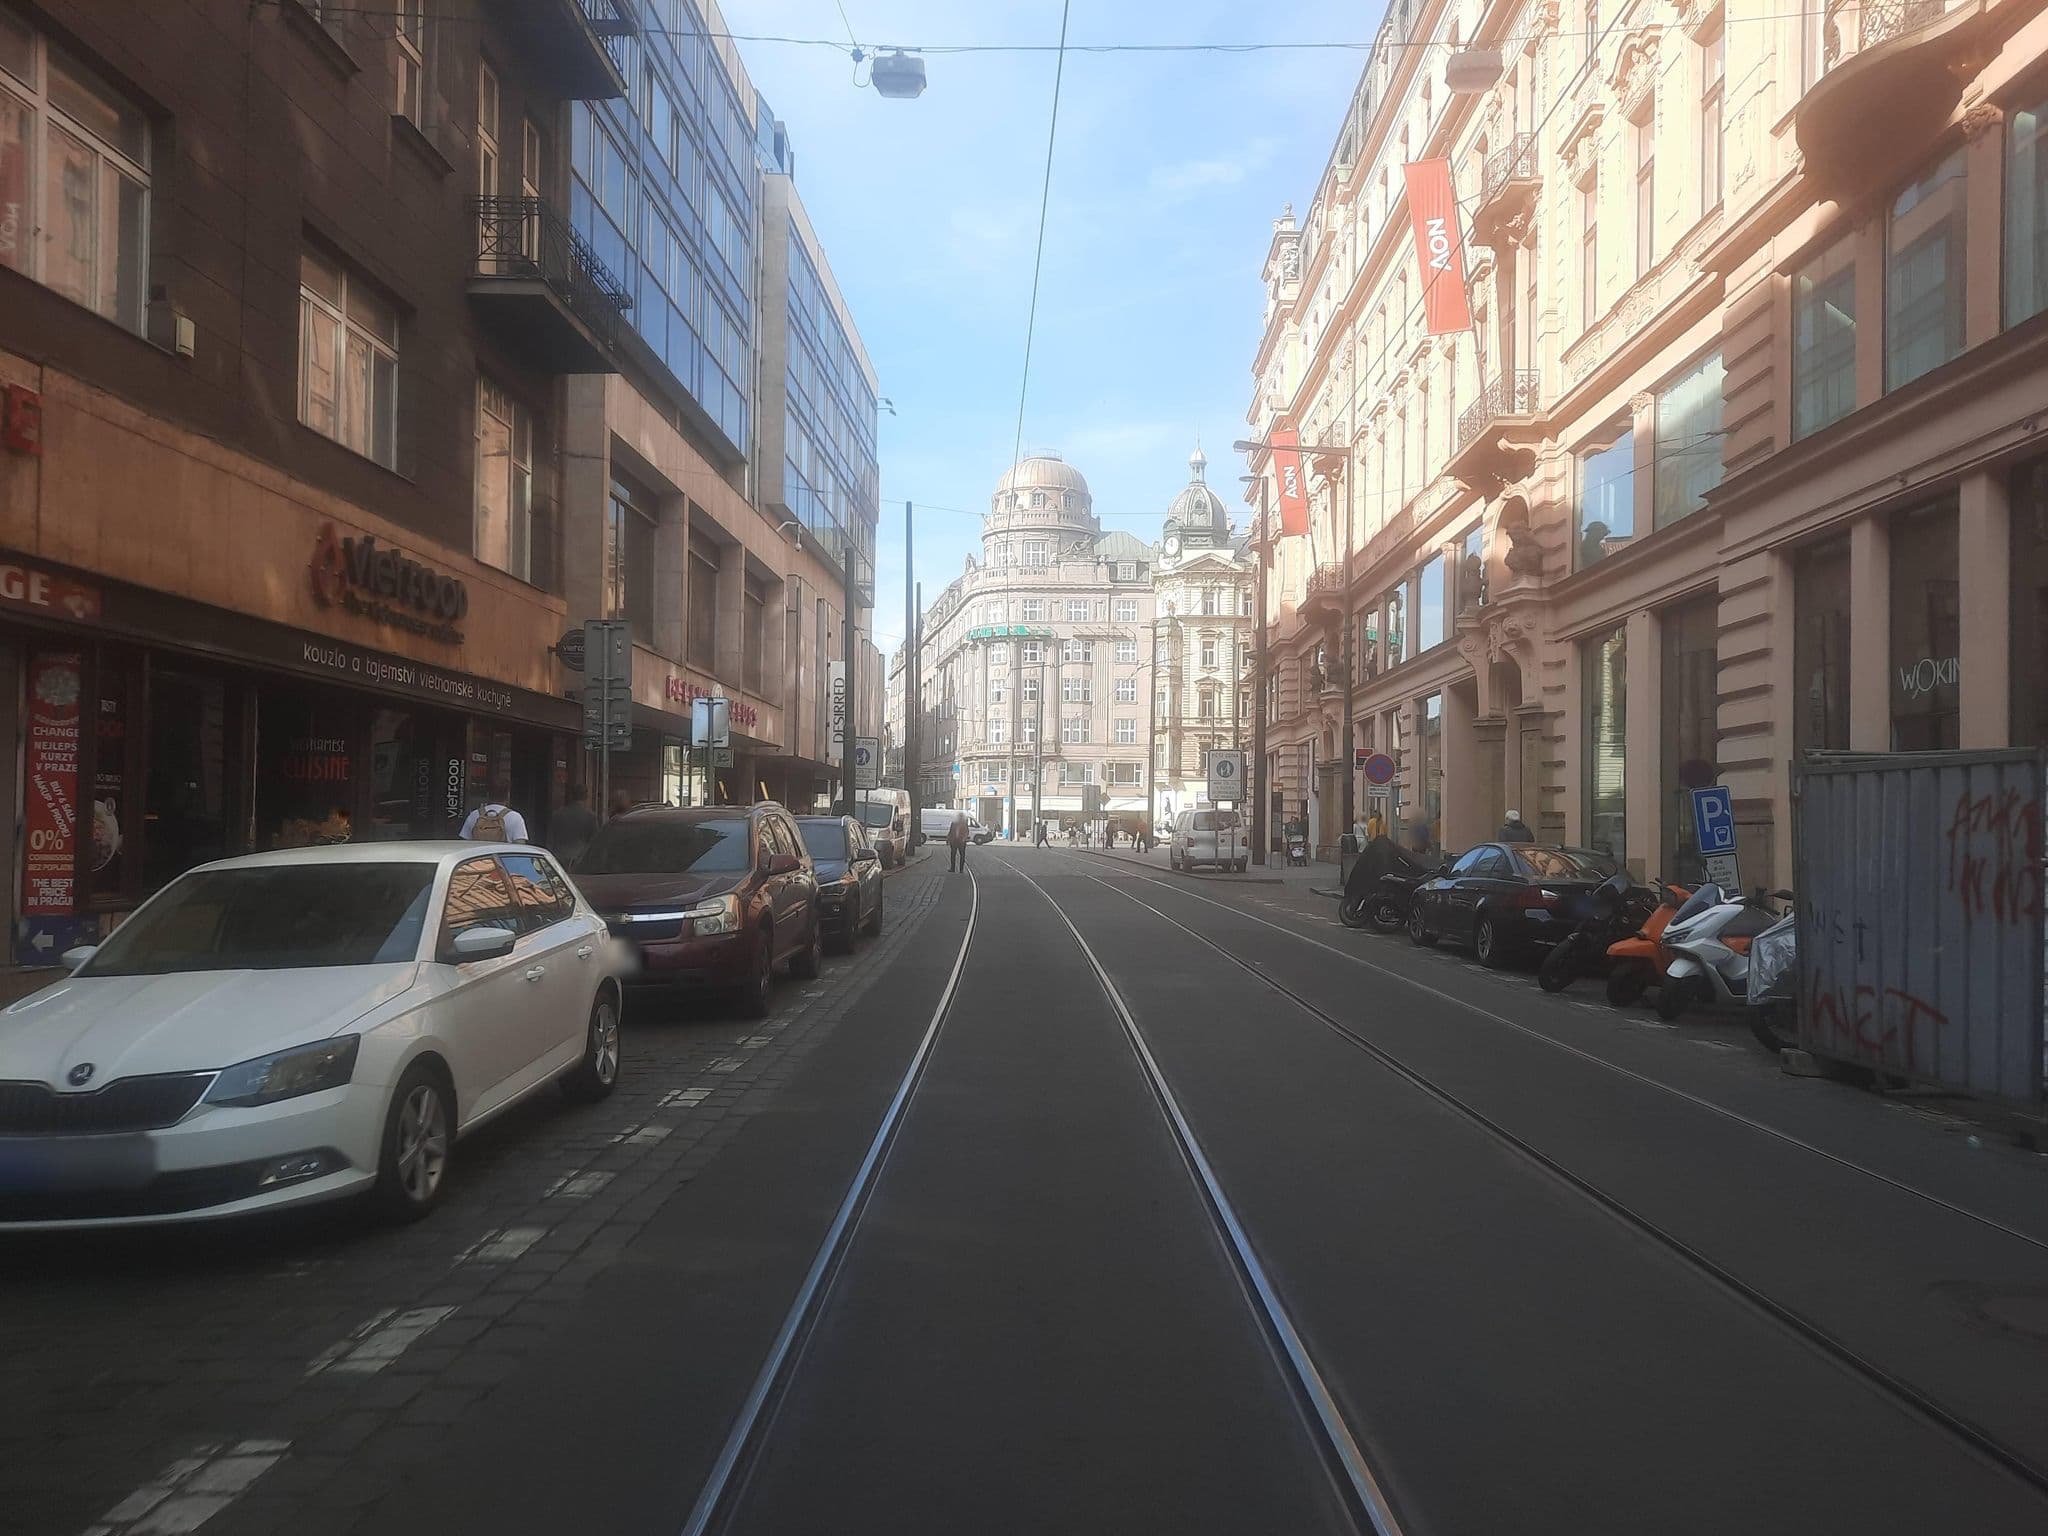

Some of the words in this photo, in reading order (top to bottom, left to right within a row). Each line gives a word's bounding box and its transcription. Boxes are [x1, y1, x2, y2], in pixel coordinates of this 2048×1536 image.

[1426, 217, 1452, 271] AON
[1283, 465, 1298, 499] AON
[303, 643, 346, 669] kouzlo
[352, 656, 360, 672] a
[833, 677, 845, 743] DESIRRED
[40, 752, 75, 761] KURZY
[44, 763, 78, 772] PRAZE
[50, 780, 64, 800] BUY
[1701, 796, 1723, 832] P
[30, 829, 64, 851] 0%
